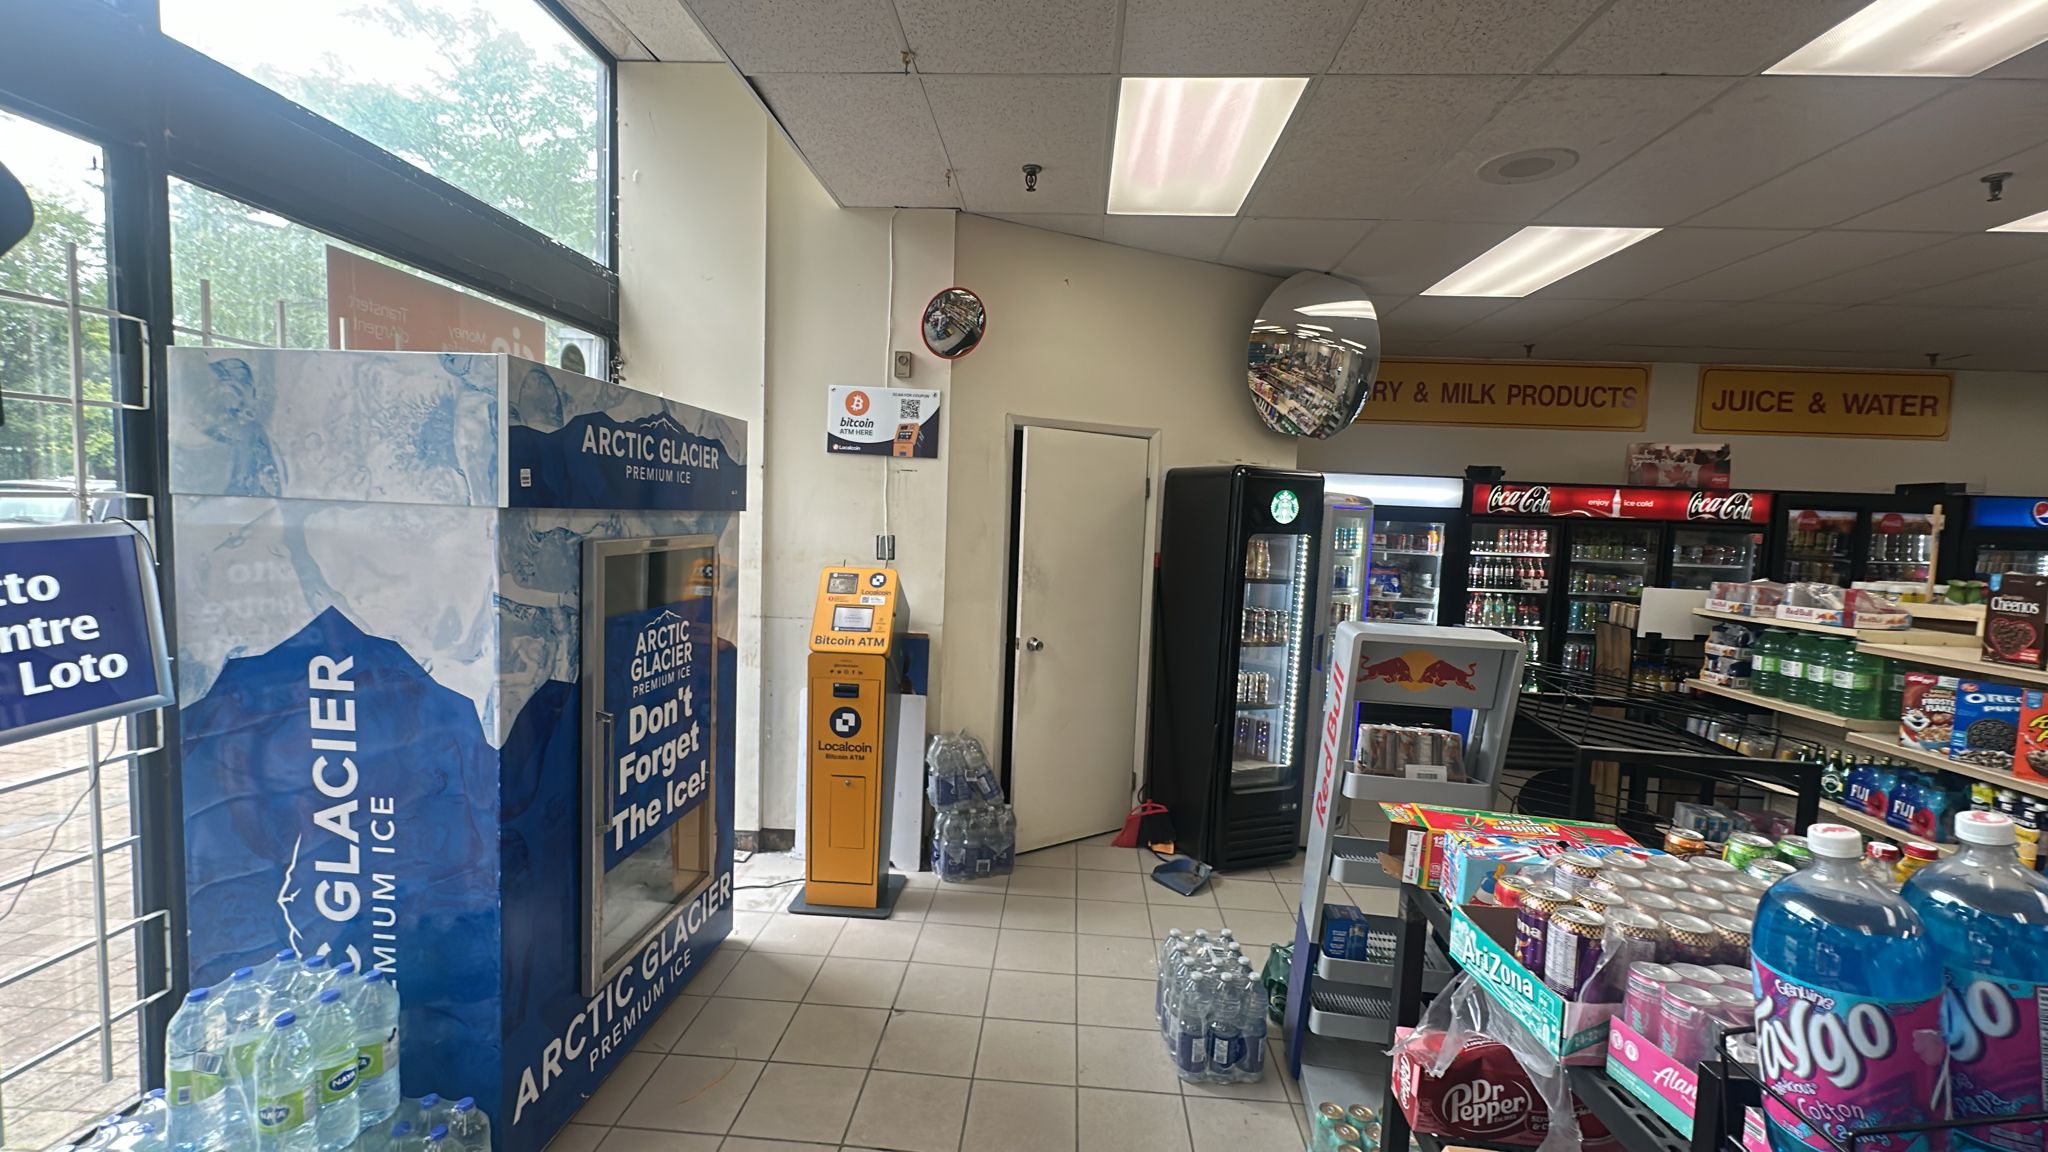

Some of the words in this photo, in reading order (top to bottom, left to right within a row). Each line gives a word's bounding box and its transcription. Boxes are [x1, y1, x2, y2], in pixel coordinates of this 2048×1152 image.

[1372, 380, 1403, 402] RY
[1413, 381, 1428, 403] &
[1441, 382, 1496, 405] MILK
[1506, 384, 1638, 408] PRODUCTS
[1711, 389, 1794, 413] JUICE
[1808, 392, 1826, 414] &
[1842, 393, 1939, 417] WATER
[840, 417, 874, 428] bitcoin
[581, 424, 654, 461] ARCTIC
[659, 438, 719, 470] GLACIER
[626, 465, 673, 483] PREMIUM
[676, 471, 692, 484] ICE
[1487, 484, 1550, 514] Coca-Cola
[1588, 499, 1610, 507] enjoy
[1636, 500, 1654, 508] cold
[1687, 491, 1752, 521] Coca-Cola
[635, 620, 690, 656] ARCTIC
[814, 635, 855, 646] Bitcoin
[857, 637, 885, 647] ATM
[18, 653, 129, 696] Loto
[630, 641, 693, 682] GLACIER
[632, 674, 675, 698] PREMIUM
[677, 665, 691, 680] ICE
[629, 684, 693, 745] Don't
[619, 720, 700, 795] Forget
[818, 741, 872, 752] Localcoin
[1315, 743, 1334, 829] Red
[1327, 661, 1345, 747] Bull
[308, 655, 361, 922] GLACIER
[612, 798, 662, 851] The
[667, 760, 707, 815] Ice!
[1851, 784, 1869, 801] FIJI
[370, 797, 396, 853] ICE
[1893, 800, 1915, 819] FIJI
[372, 874, 397, 988] MIUM
[1462, 934, 1534, 1000] AriZona
[513, 965, 634, 1126] ARCTIC
[641, 871, 731, 981] GLACIER
[589, 977, 665, 1072] PREMIUM
[669, 948, 692, 984] ICE
[1775, 979, 1834, 1010] Genuine
[1754, 996, 1890, 1088] Faygo
[332, 1067, 358, 1090] NAYA
[1471, 1079, 1504, 1103] Dr
[1450, 1083, 1525, 1126] Pepper
[1797, 1097, 1865, 1122] Cotton
